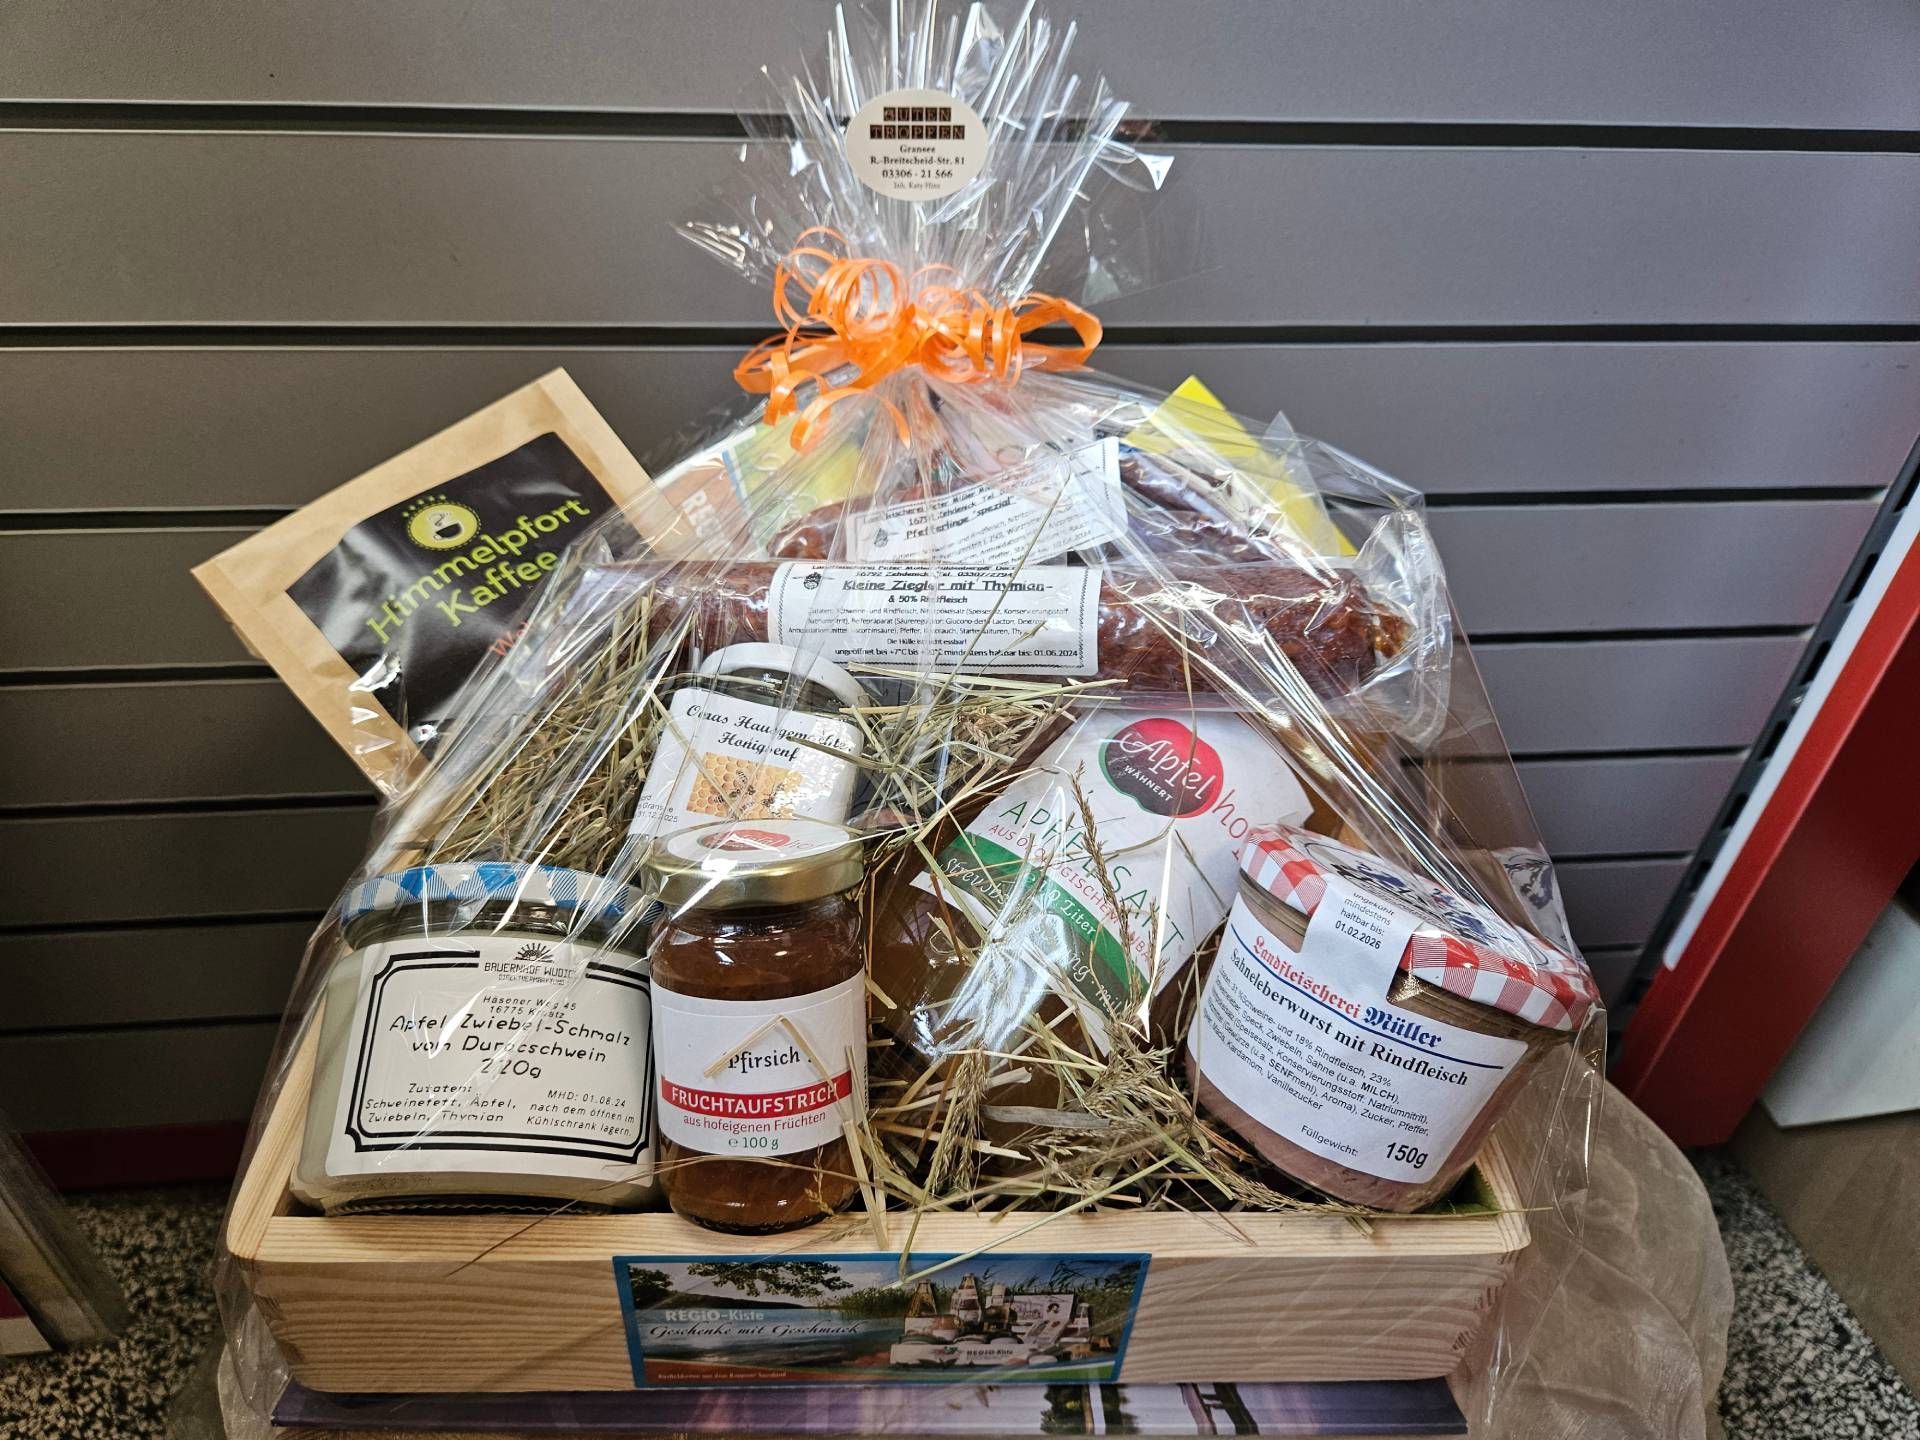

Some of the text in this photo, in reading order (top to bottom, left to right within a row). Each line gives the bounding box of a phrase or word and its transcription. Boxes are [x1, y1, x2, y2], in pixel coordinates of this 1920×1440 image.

[882, 169, 912, 178] 03306
[366, 499, 590, 644] Himmelpfort
[842, 580, 885, 592] Kleine
[950, 580, 976, 591] mit
[435, 551, 558, 627] Kaffee
[898, 595, 918, 603] 50%
[920, 595, 968, 604] Rifleisch
[876, 648, 888, 656] bei
[908, 648, 919, 656] bis
[1120, 732, 1216, 799] Apfel
[989, 824, 1017, 842] AUS
[1060, 899, 1098, 935] Liter
[1340, 908, 1385, 937] haltbar bis:
[1344, 898, 1391, 927] mindestens
[1335, 920, 1381, 950] 01.02.2026
[1253, 935, 1361, 1019] Landfleischerei
[1363, 1006, 1442, 1048] Müller
[489, 1005, 565, 1019] 16775 Kratz
[1230, 948, 1332, 1035] Sahneleberwurst
[1334, 1030, 1366, 1052] mit
[1369, 1041, 1469, 1086] Rindfleisch
[389, 1013, 632, 1047] Apfel Zwiebel-Schmalz
[462, 1035, 607, 1063] Durocschwein
[727, 1046, 801, 1074] Pfirsich
[1266, 1028, 1303, 1060] Zwiebeln,
[1306, 1054, 1335, 1077] Sahne
[1277, 1022, 1293, 1037] und
[1295, 1033, 1313, 1050] 18%
[1314, 1045, 1367, 1079] Rindfleisch,
[1369, 1072, 1391, 1087] 23%
[547, 1089, 579, 1101] MHD:
[671, 1082, 838, 1115] FRUCHTAUFSTRICH
[1266, 1070, 1324, 1110] Vanillezucker
[365, 1098, 461, 1110] Schweinefett,
[530, 1102, 559, 1113] nach
[563, 1105, 586, 1116] dem
[625, 1115, 635, 1124] im
[368, 1112, 430, 1123] Zwiebeln,
[441, 1109, 504, 1122] Thymian
[600, 1125, 632, 1137] lagern.
[683, 1111, 826, 1135] aus hofeigenen Früchten
[1360, 1108, 1396, 1129] Zucker,
[1398, 1119, 1429, 1138] Pfeffer,
[743, 1137, 768, 1149] 100
[771, 1138, 779, 1150] g
[1300, 1125, 1429, 1170] Füllgewicht: 150g
[649, 1319, 867, 1338] Geschenke mit Geschmack
